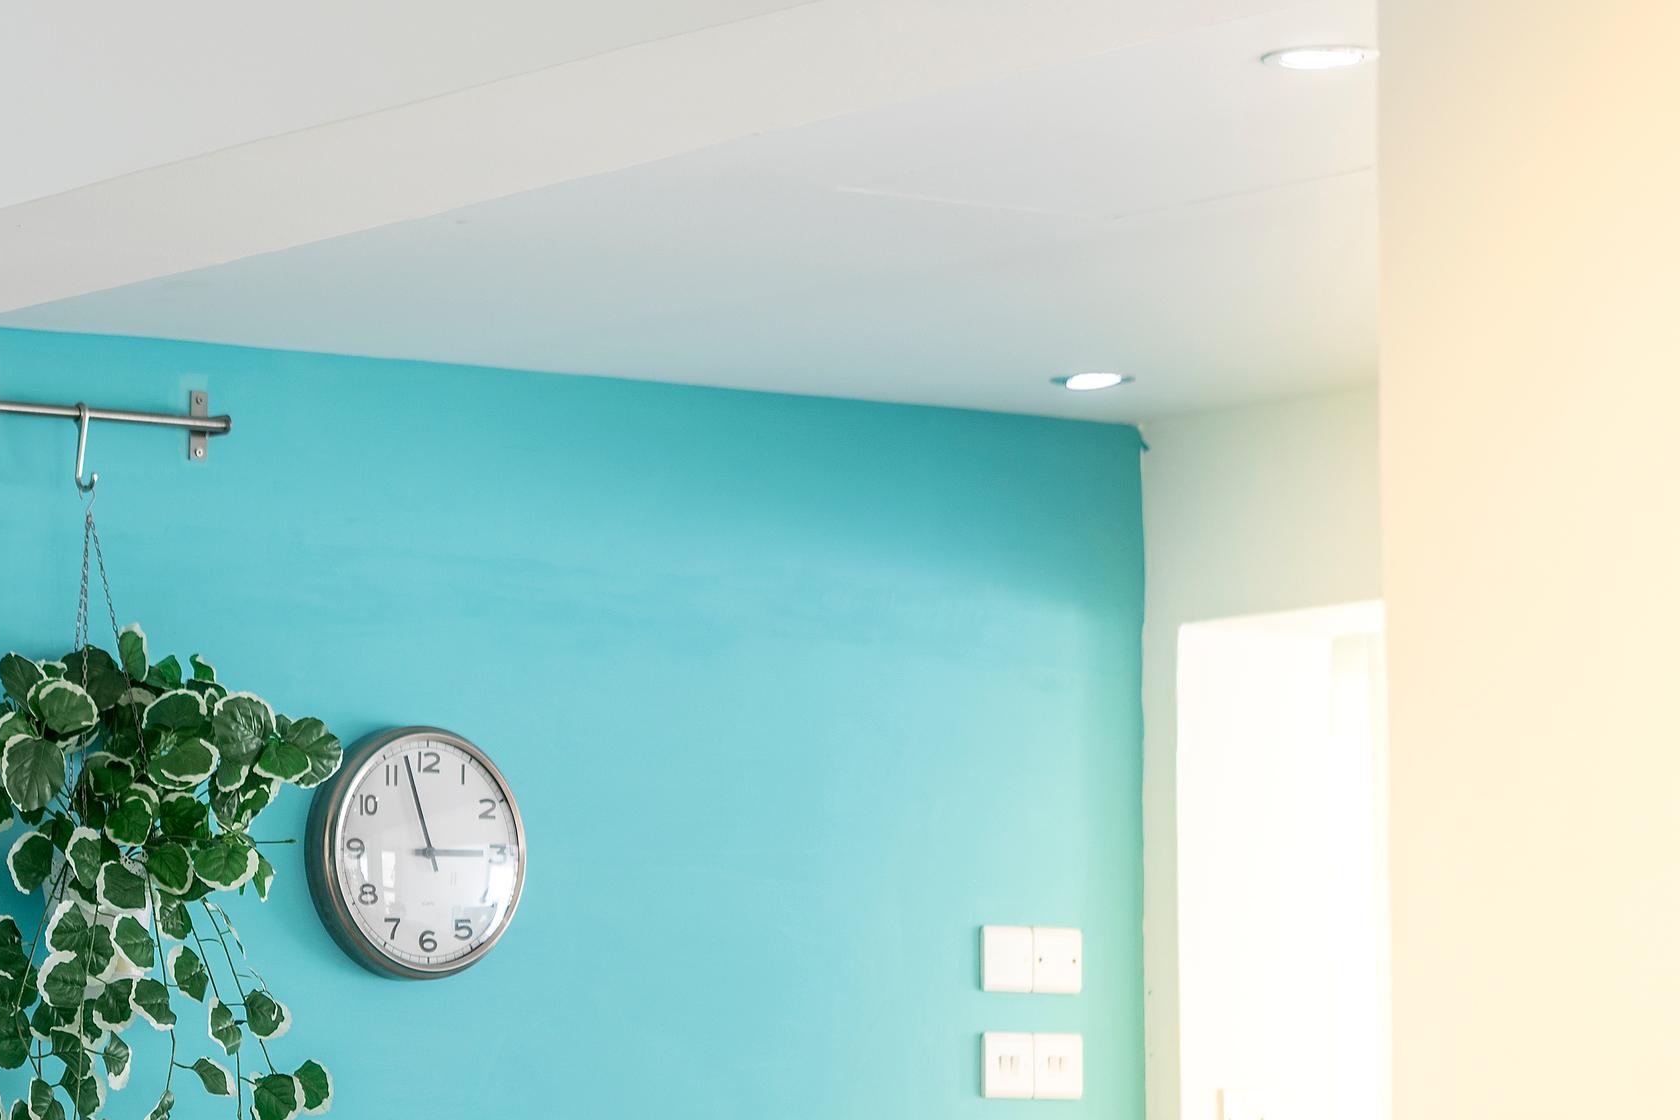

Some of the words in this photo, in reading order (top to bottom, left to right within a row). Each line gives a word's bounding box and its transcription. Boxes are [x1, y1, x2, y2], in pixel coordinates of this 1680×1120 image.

[418, 752, 440, 773] 12
[385, 765, 398, 786] 11
[460, 764, 466, 785] 1
[359, 795, 378, 816] 10
[478, 799, 497, 819] 2
[346, 838, 365, 859] 9
[489, 844, 507, 864] 3
[358, 884, 379, 905] 8
[384, 918, 401, 940] 7
[454, 919, 473, 941] 5
[419, 931, 438, 953] 6
